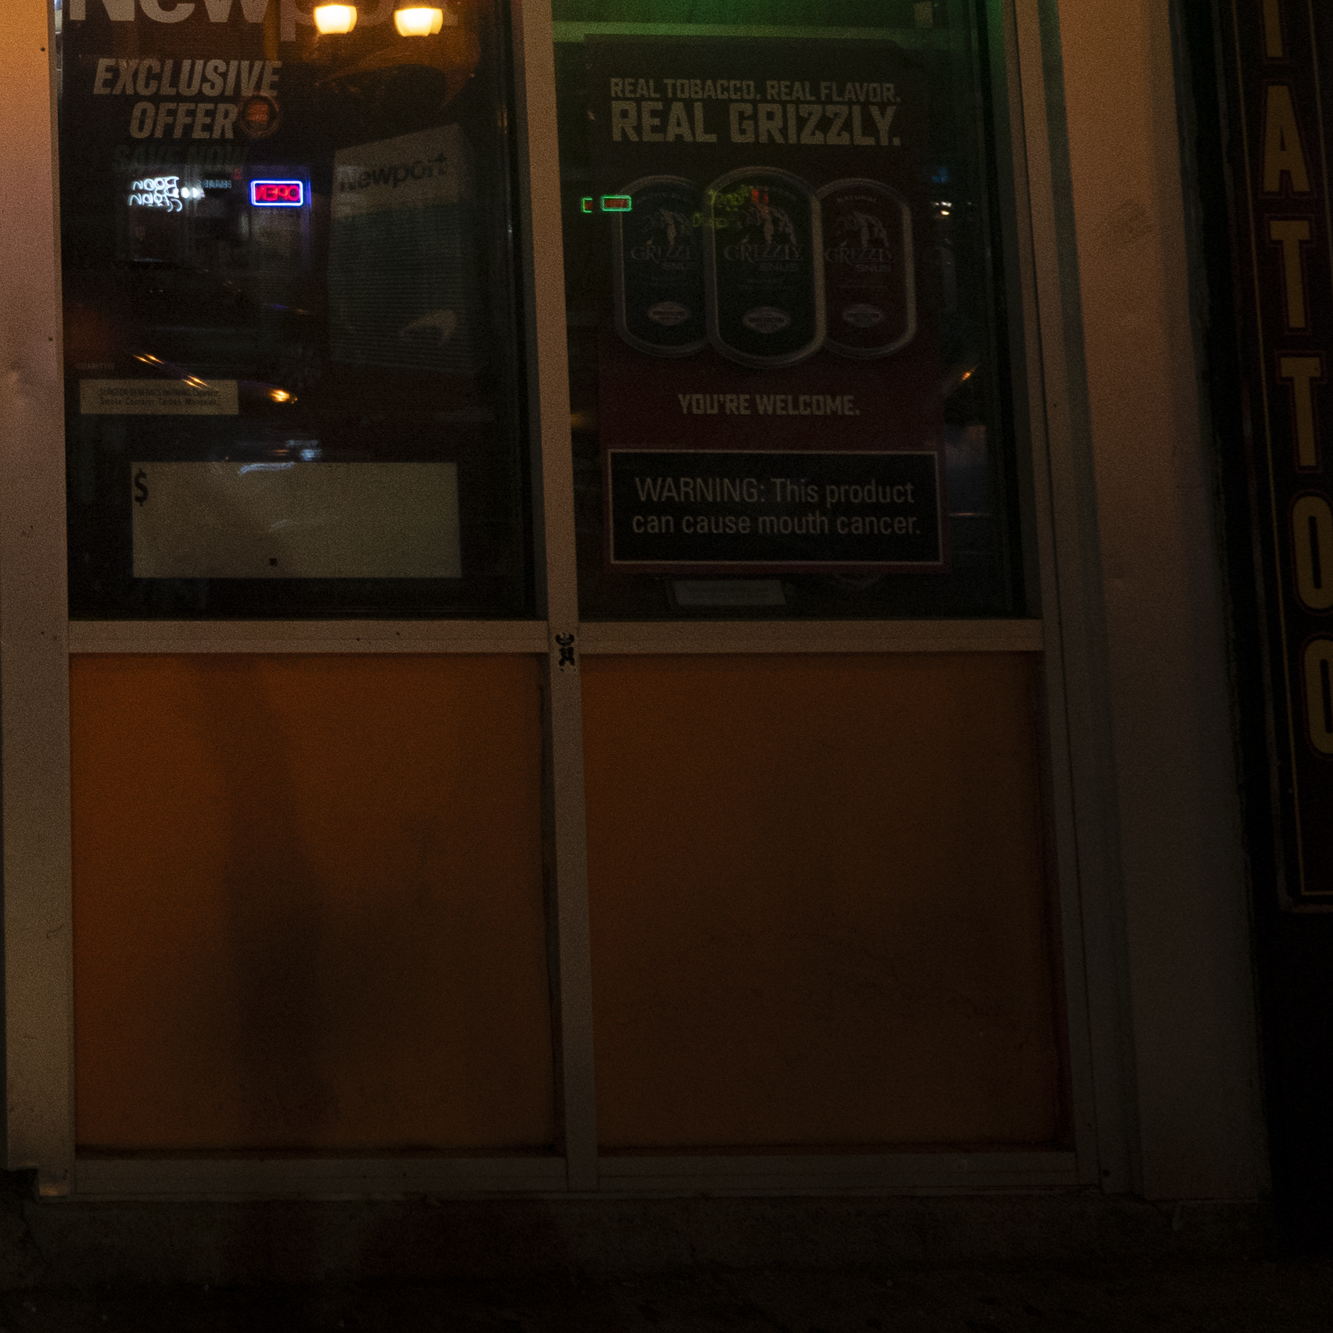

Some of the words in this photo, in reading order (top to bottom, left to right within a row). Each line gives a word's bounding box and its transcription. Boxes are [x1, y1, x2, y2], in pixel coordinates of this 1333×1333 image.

[93, 57, 283, 97] EXCLUSIVE
[609, 77, 661, 99] REAL
[666, 78, 761, 101] TOBACCO.
[766, 80, 816, 101] REAL
[820, 82, 902, 103] FLAVOR.
[129, 101, 239, 140] OFFER
[610, 100, 719, 143] REAL
[729, 103, 901, 147] GRIZZLY.
[678, 393, 751, 416] YOU'RE
[755, 394, 861, 416] WELCOME.
[133, 469, 150, 507] $
[635, 476, 766, 504] WARNING:
[771, 477, 819, 504] This
[826, 479, 915, 508] product
[633, 513, 675, 535] can
[681, 514, 752, 535] cause
[757, 510, 829, 535] mouth
[836, 515, 921, 536] cancer.
